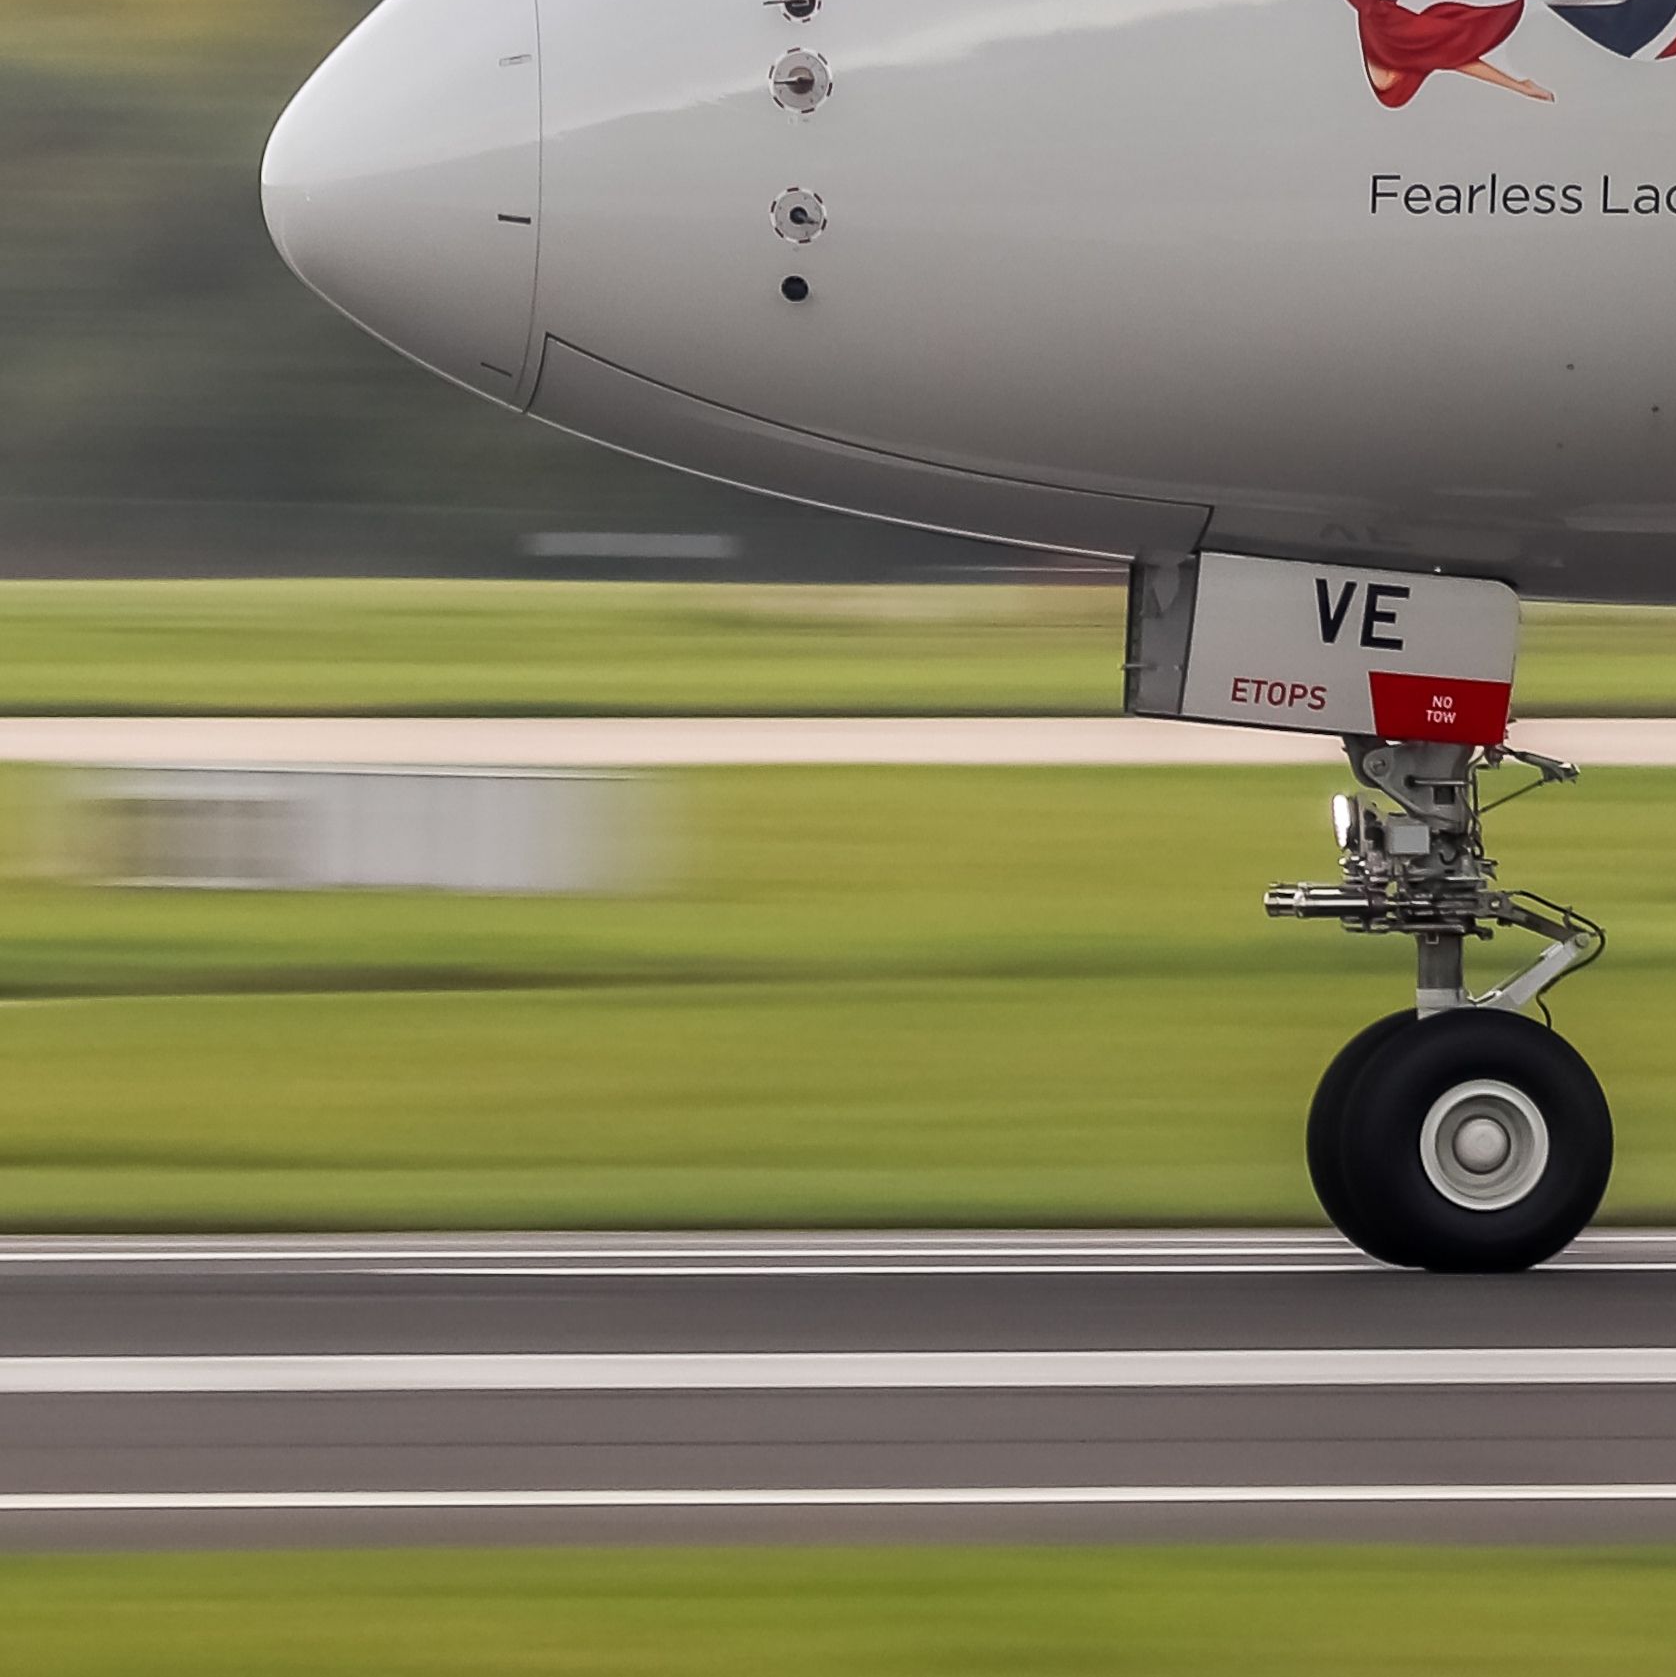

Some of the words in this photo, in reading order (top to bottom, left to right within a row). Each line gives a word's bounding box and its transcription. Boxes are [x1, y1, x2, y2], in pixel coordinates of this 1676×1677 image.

[1371, 172, 1583, 215] Fearless
[1315, 578, 1410, 651] VE
[1231, 677, 1327, 710] ETOPS
[1432, 695, 1453, 709] NO
[1425, 709, 1457, 724] TOW
